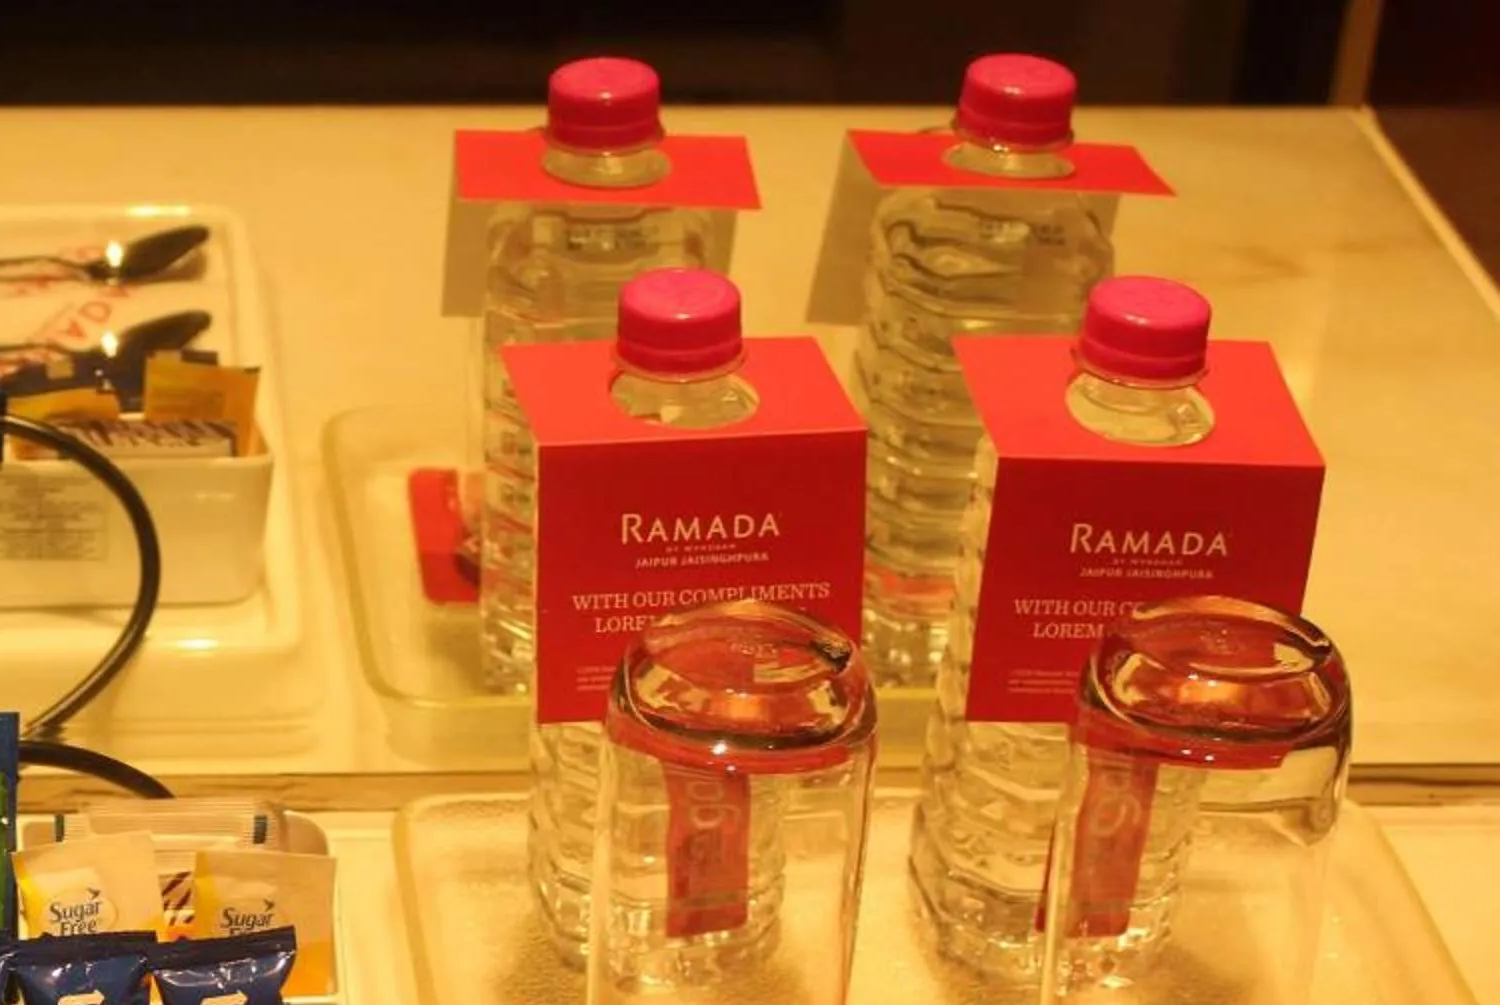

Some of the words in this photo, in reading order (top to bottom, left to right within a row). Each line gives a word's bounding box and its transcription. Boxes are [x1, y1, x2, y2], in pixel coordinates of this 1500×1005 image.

[621, 512, 781, 545] RAMADA
[1070, 522, 1228, 557] RAMADA
[572, 591, 629, 611] WITH
[632, 588, 677, 608] OUR
[1014, 598, 1070, 616] WITH
[1071, 599, 1116, 617] OUR
[595, 615, 656, 634] LORE
[1032, 622, 1105, 639] LOREM
[50, 899, 102, 924] Sugar
[220, 907, 274, 930] Sugar
[60, 919, 97, 936] Free
